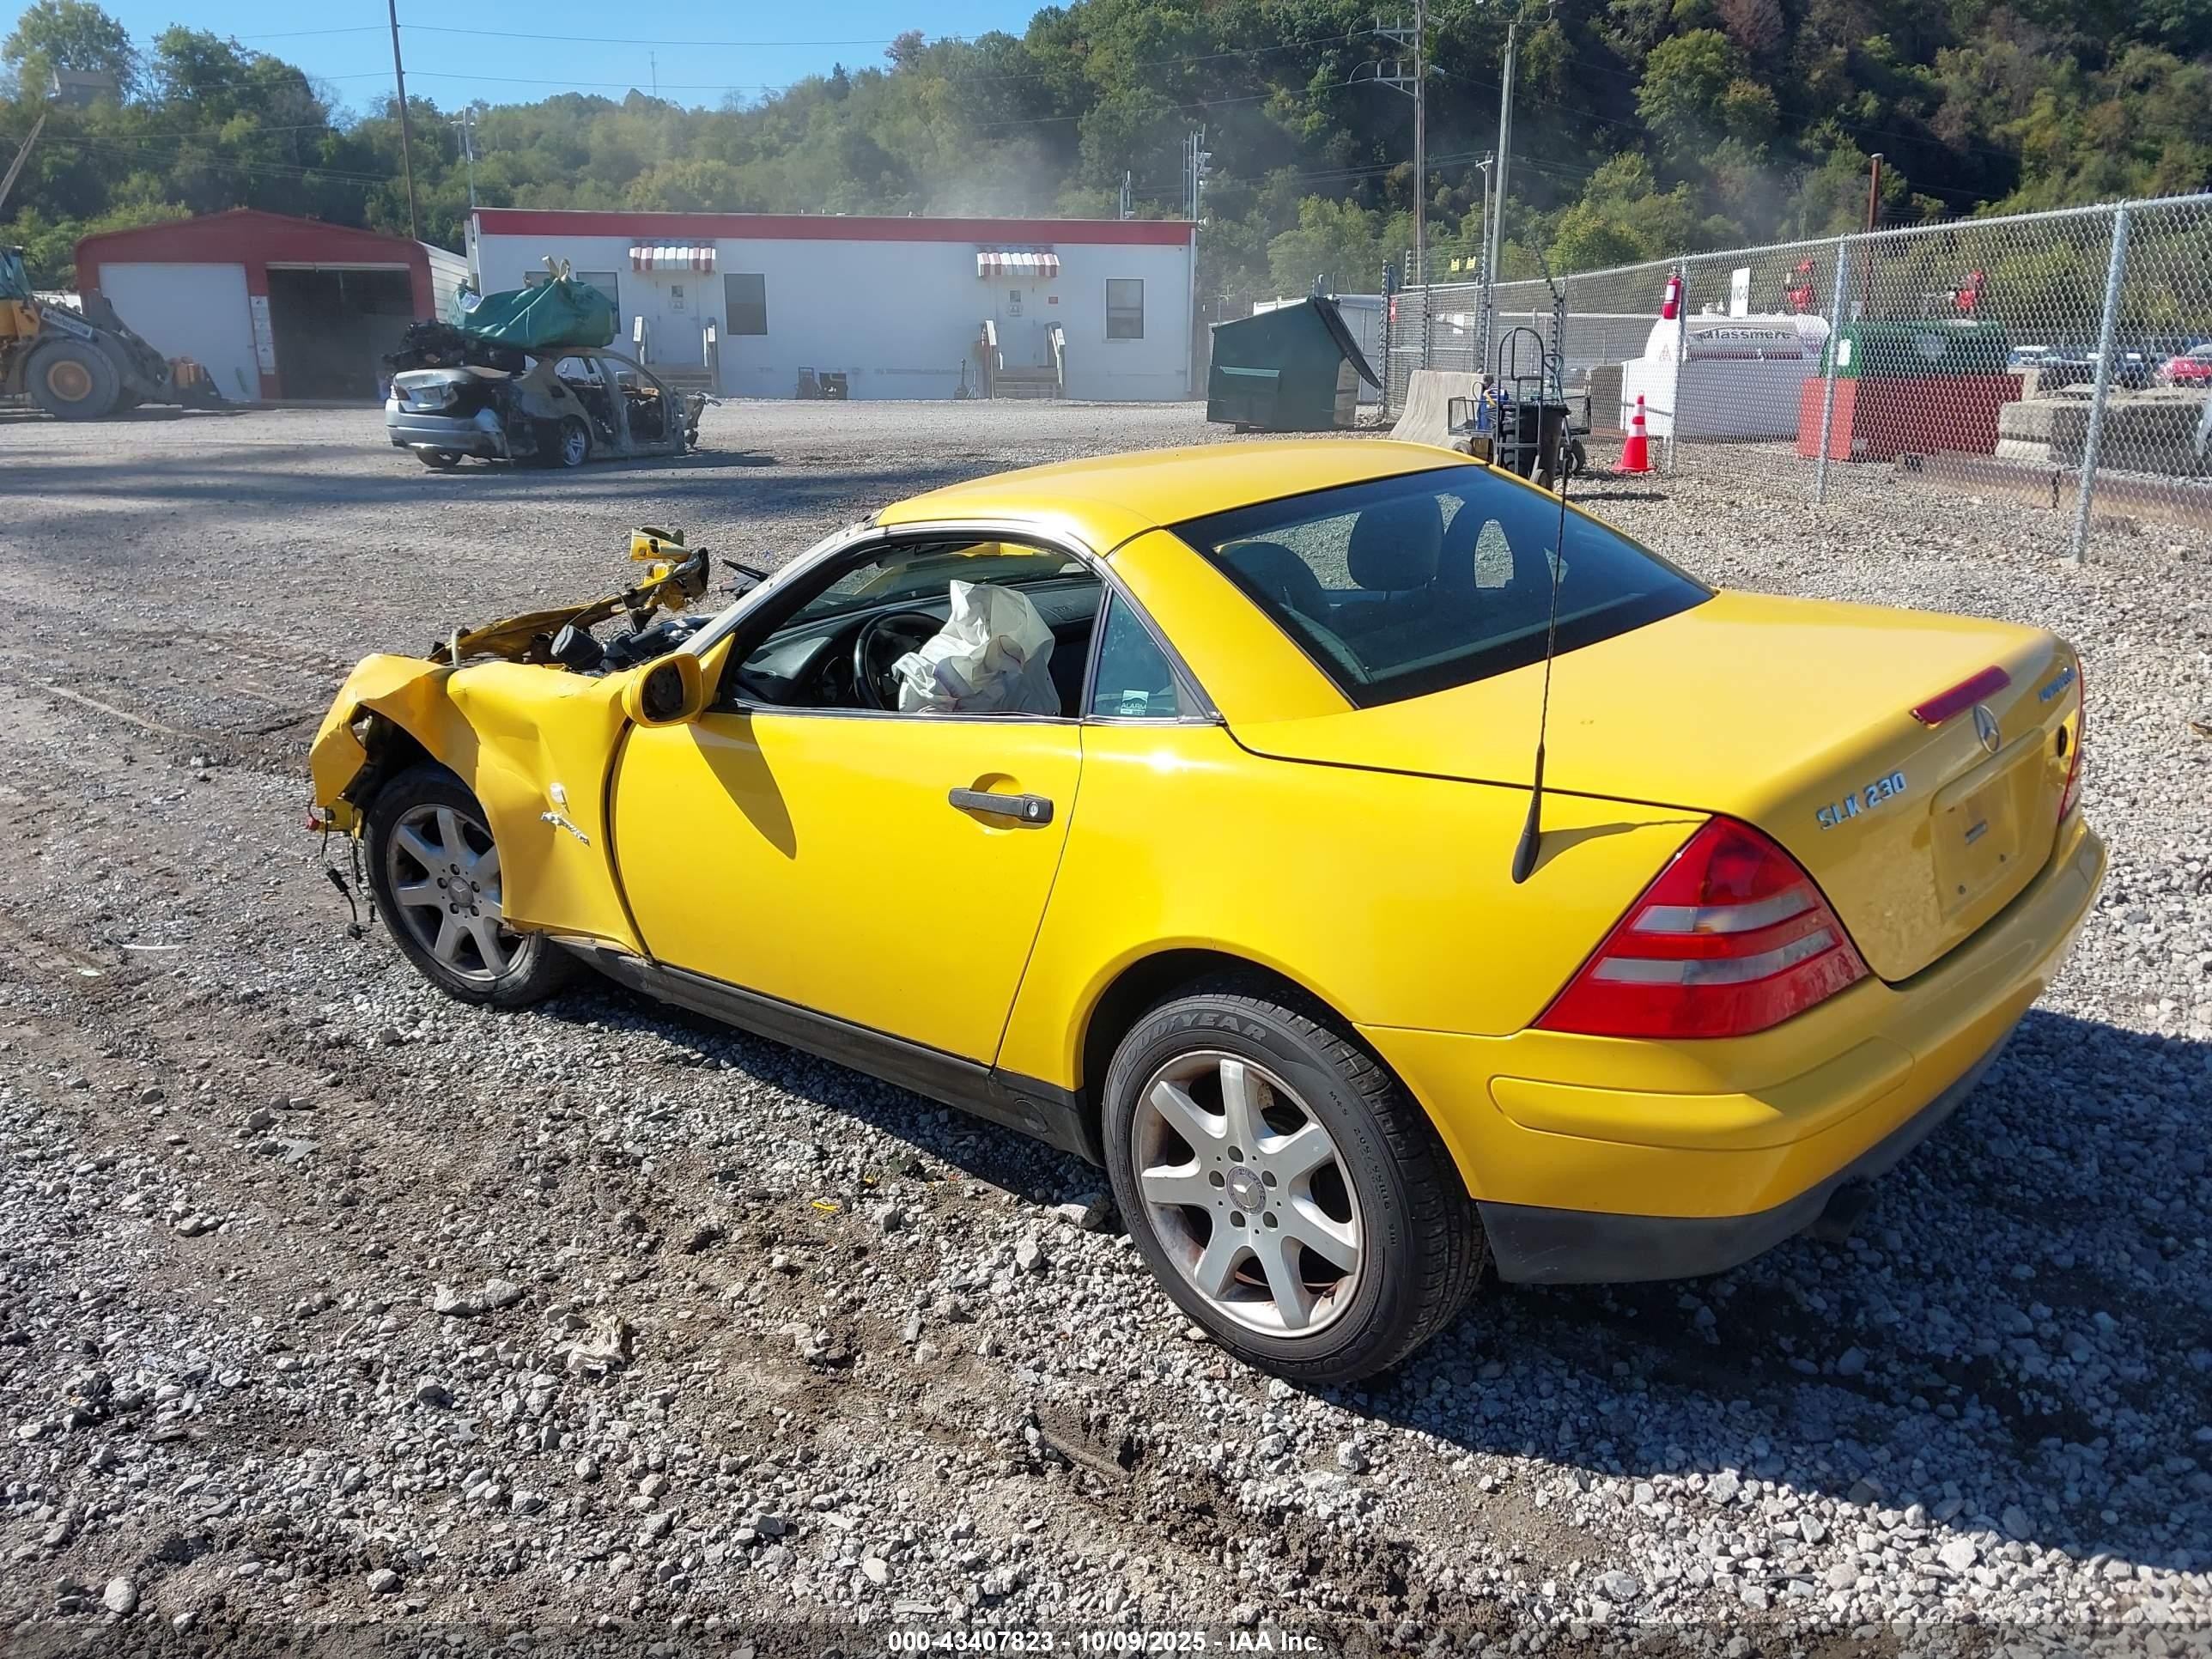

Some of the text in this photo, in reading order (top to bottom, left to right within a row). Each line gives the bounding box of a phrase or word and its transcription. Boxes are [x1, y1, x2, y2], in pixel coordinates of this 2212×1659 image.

[1815, 770, 1907, 830] SLK 230
[1118, 1012, 1267, 1085] GOODYEAR
